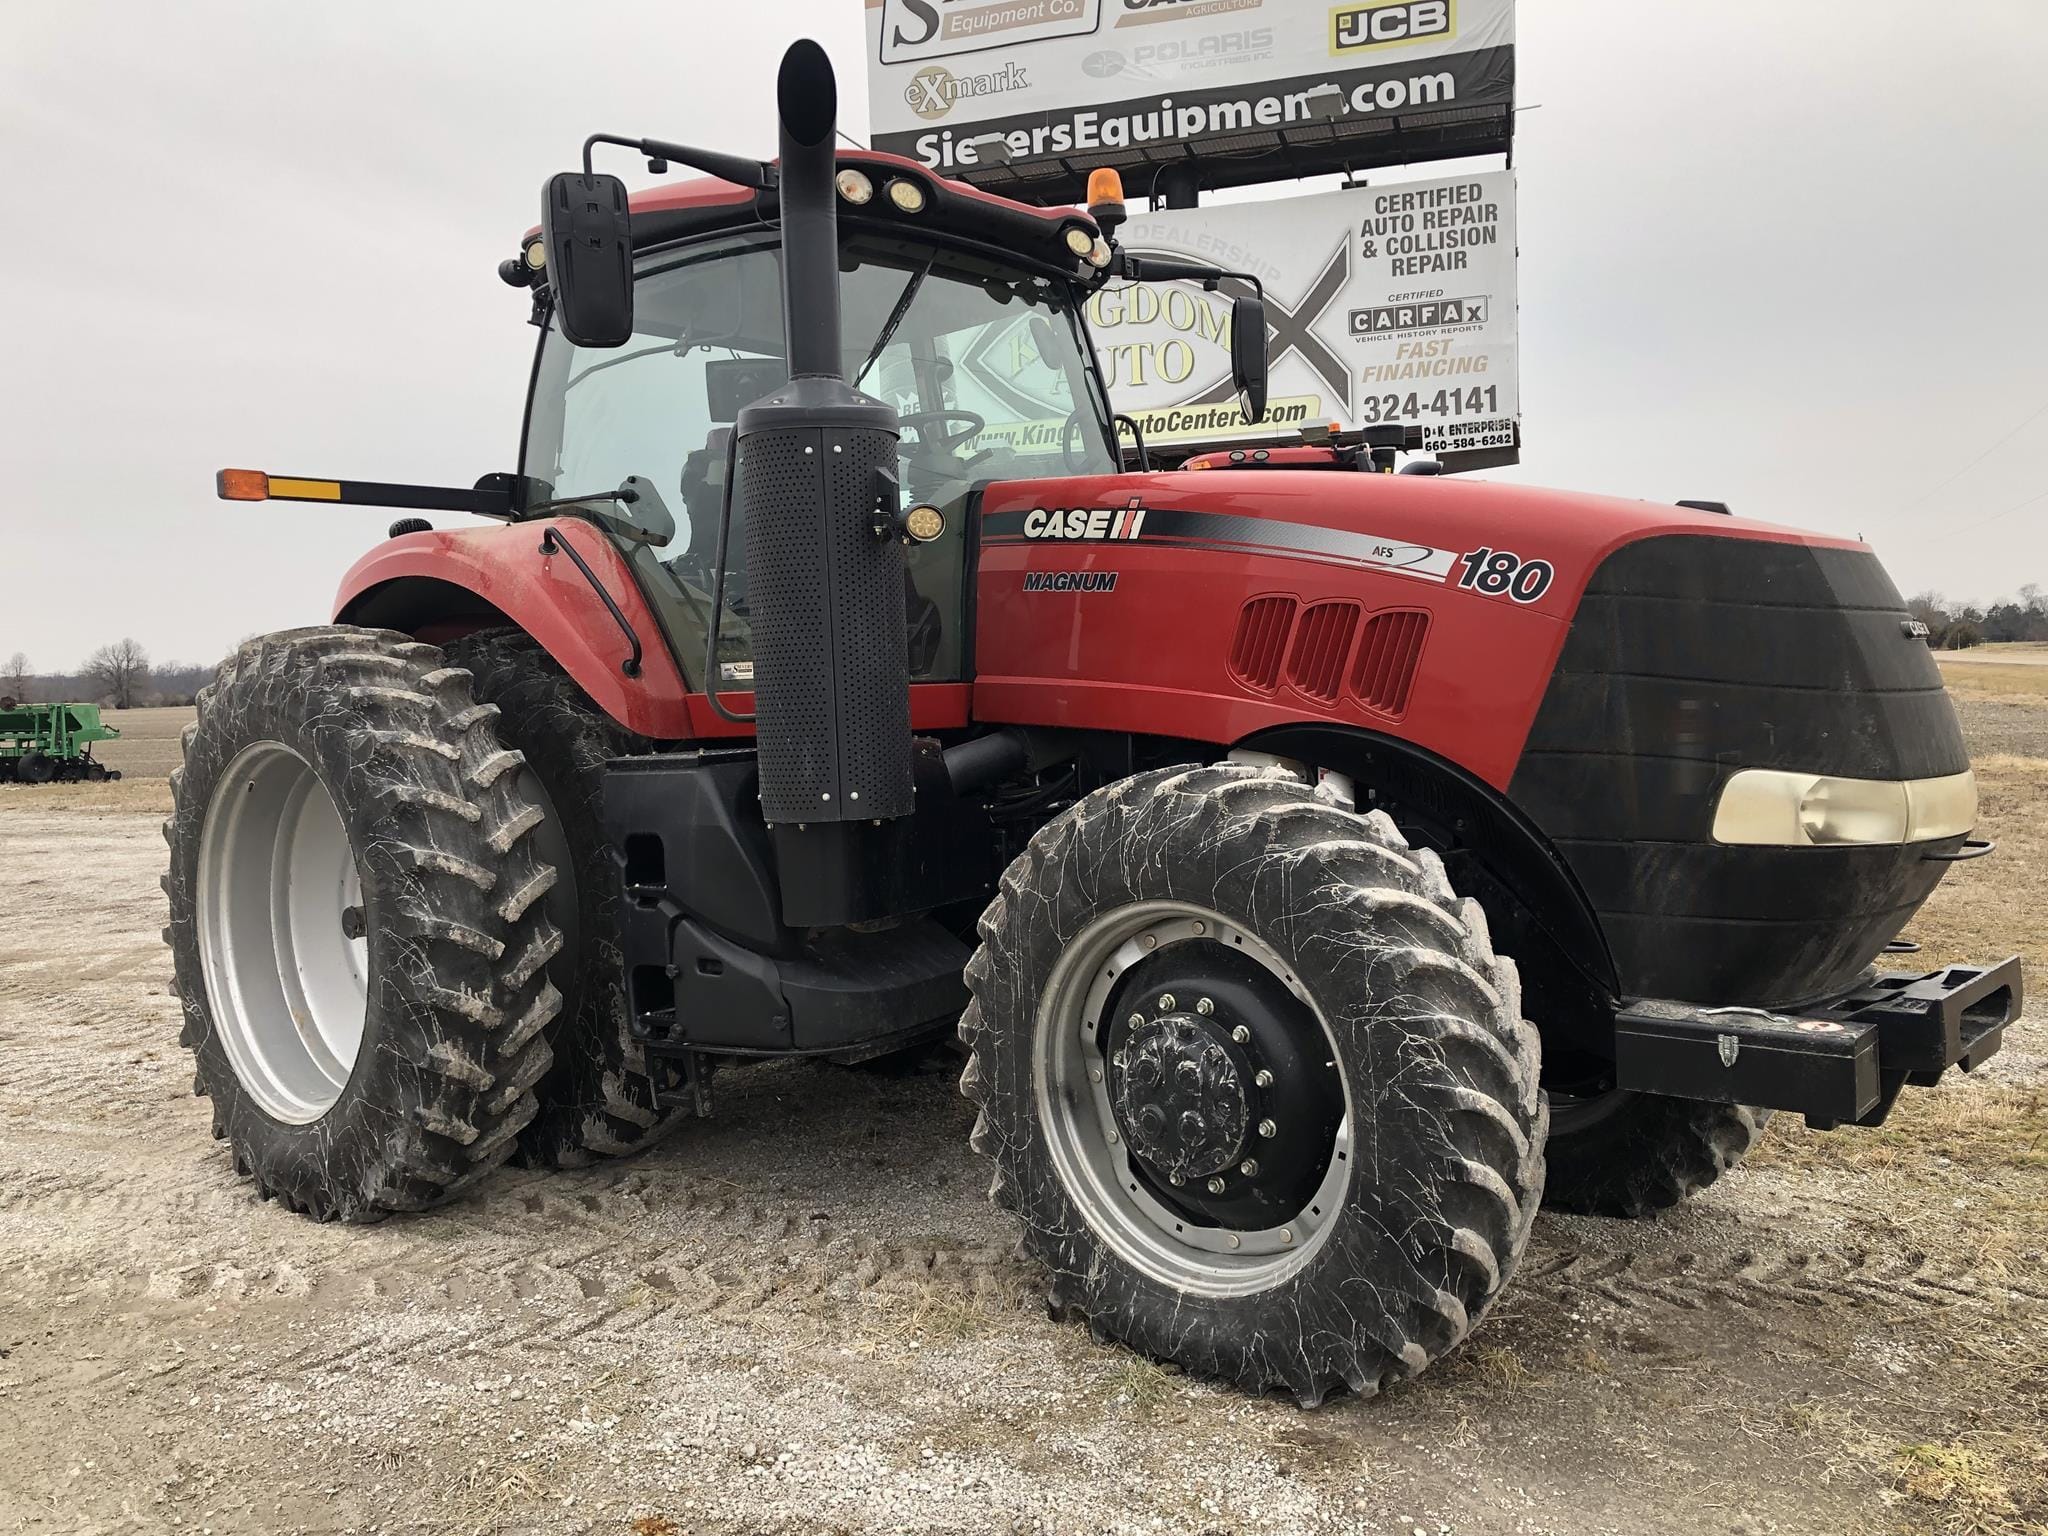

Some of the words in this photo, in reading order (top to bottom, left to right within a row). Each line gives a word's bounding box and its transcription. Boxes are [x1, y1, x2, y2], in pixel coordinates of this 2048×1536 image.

[951, 4, 1045, 33] Equipment
[1049, 0, 1079, 15] Co.
[1185, 0, 1260, 17] AGRICULTURE
[1339, 0, 1447, 45] JCB
[1134, 27, 1275, 65] POLARIS
[915, 71, 1456, 170] SieersEquipmen.com
[1375, 183, 1483, 215] CERTIFIED
[1360, 214, 1414, 238] AUTO
[1423, 203, 1498, 230] REPAIR
[1134, 224, 1282, 283] DEALERSHIP
[1362, 240, 1378, 259] &
[1386, 225, 1497, 256] COLLISION
[1392, 250, 1467, 277] REPAIR
[1388, 289, 1444, 302] CERTIFIED
[1354, 304, 1482, 331] CARFAX
[1355, 334, 1393, 344] VEHICLE
[1397, 329, 1437, 339] HISTORY
[1441, 325, 1484, 335] REPORTS
[1396, 338, 1454, 360] FAST
[1362, 355, 1489, 383] FINANCING
[1363, 384, 1498, 423] 324-4141
[1425, 433, 1512, 452] 660-584-6242
[1372, 545, 1394, 558] AFS
[1023, 571, 1119, 592] MAGNUM
[1457, 546, 1555, 604] 180
